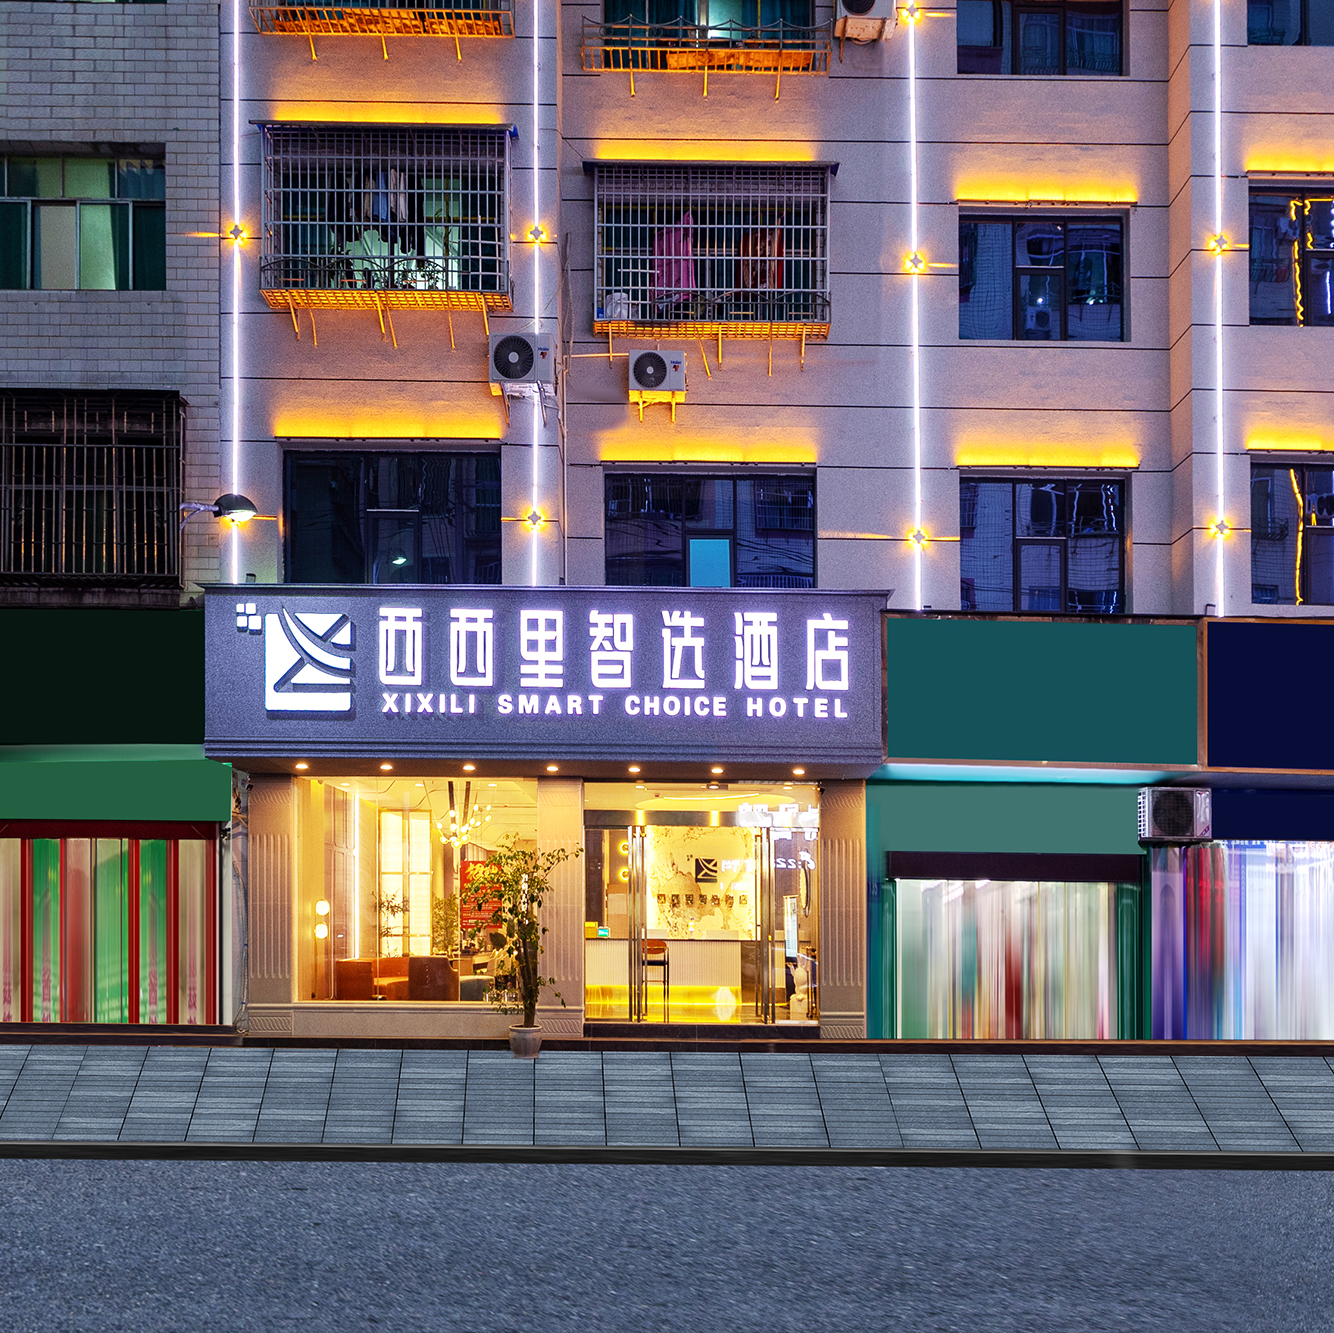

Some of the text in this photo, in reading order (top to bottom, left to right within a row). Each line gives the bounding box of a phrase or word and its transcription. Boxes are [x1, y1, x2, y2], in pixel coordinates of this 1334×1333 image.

[378, 607, 849, 691] 西西里智选酒店
[381, 692, 848, 718] XIXILI SMART CHOICE HOTEL
